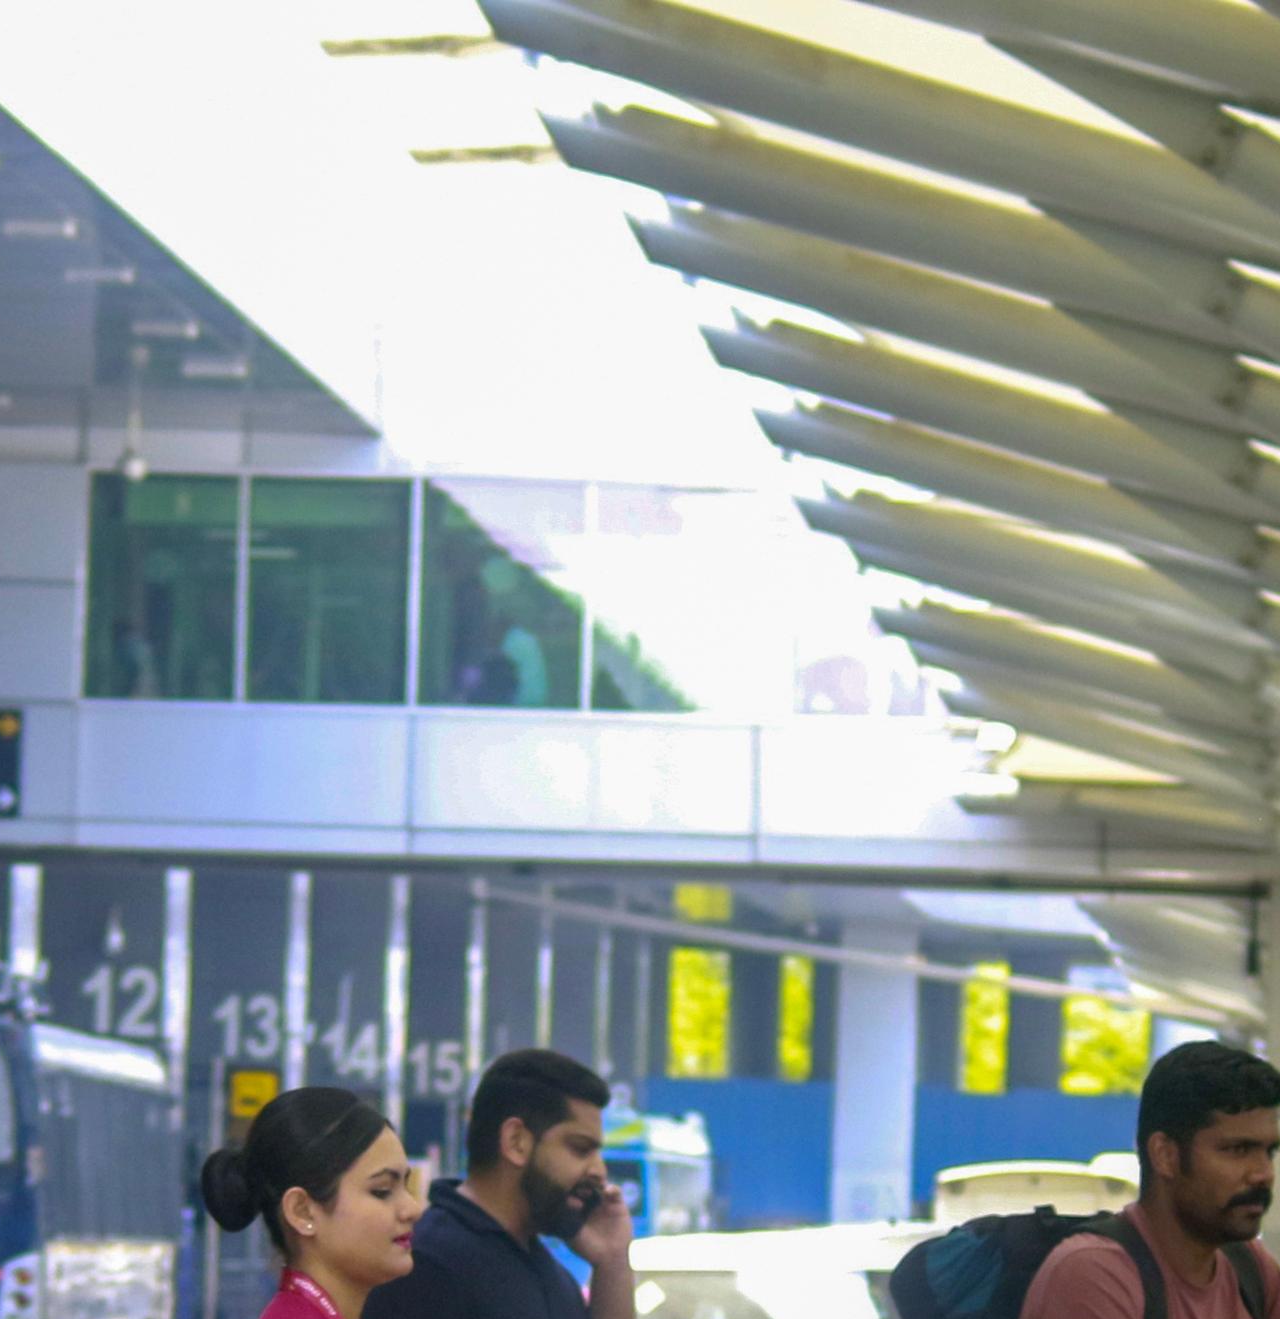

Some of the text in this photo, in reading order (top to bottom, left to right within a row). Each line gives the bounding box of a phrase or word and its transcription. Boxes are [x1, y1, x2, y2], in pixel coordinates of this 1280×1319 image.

[83, 964, 161, 1038] 12
[213, 995, 281, 1059] 13
[322, 1020, 379, 1081] 14
[408, 1040, 464, 1096] 15
